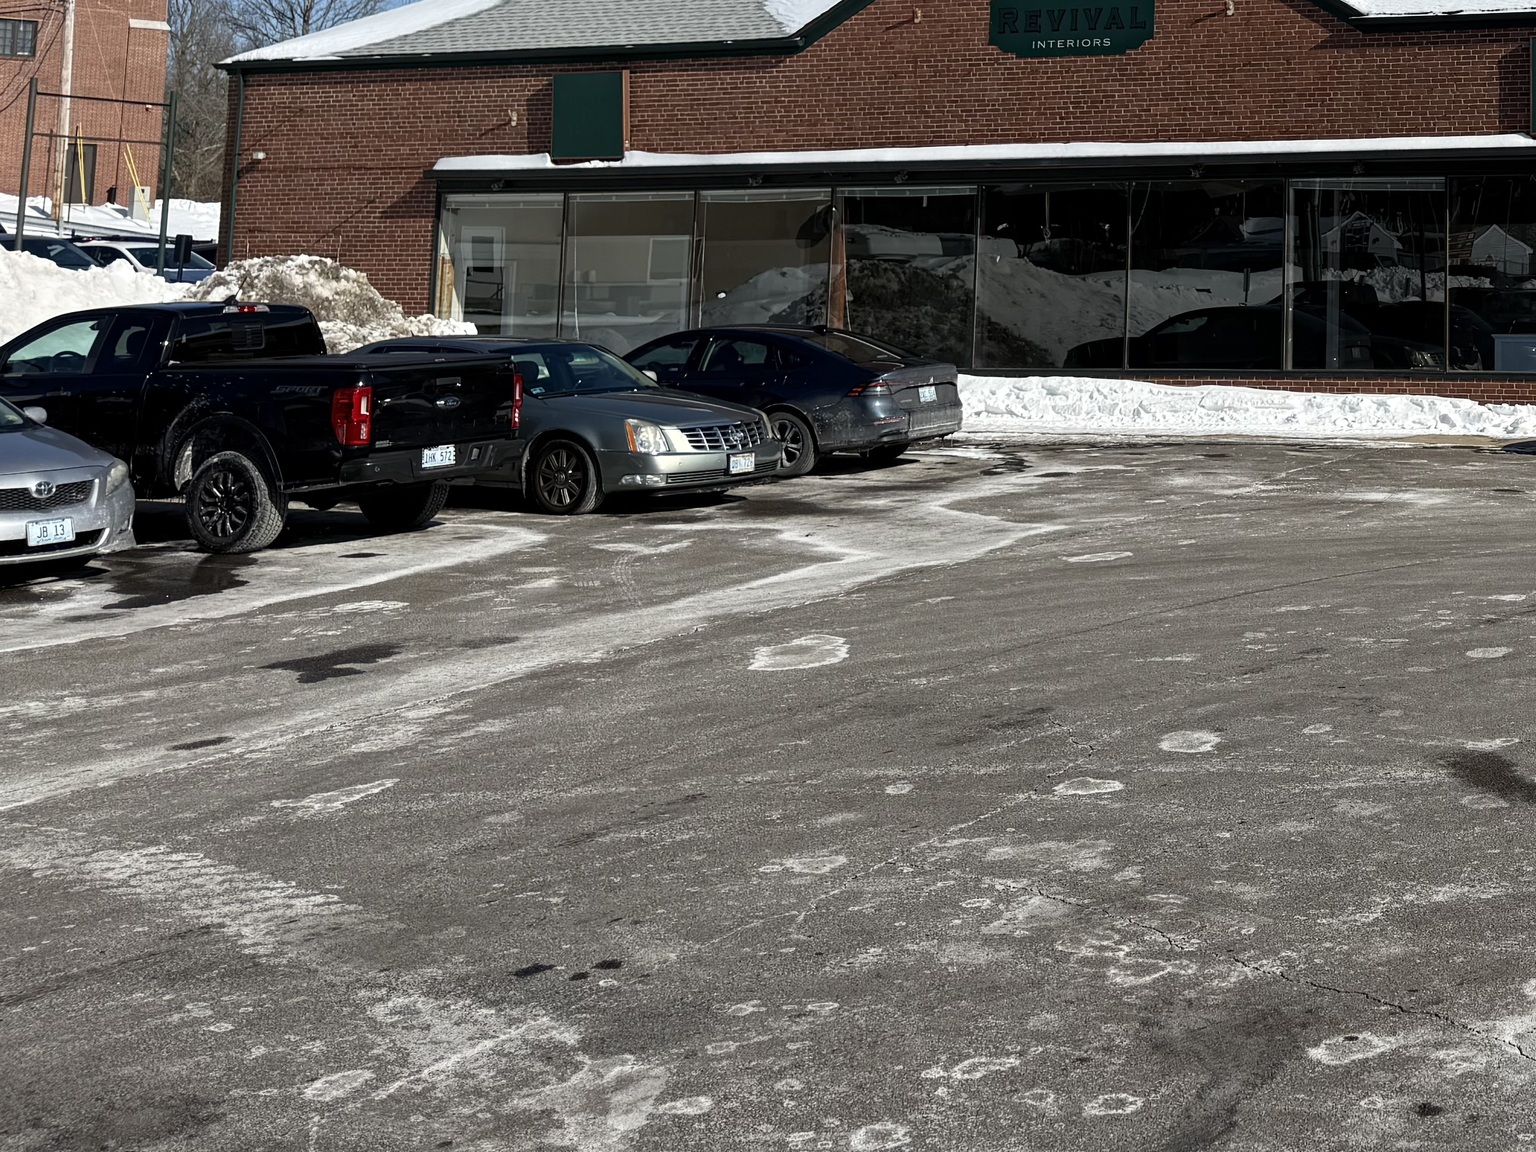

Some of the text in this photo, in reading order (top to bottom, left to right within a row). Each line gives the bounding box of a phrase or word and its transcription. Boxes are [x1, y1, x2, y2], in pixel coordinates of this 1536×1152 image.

[997, 6, 1147, 34] REVIVAL
[1032, 38, 1112, 49] INTERIORS
[440, 450, 452, 462] 572
[36, 523, 65, 539] JB 13
